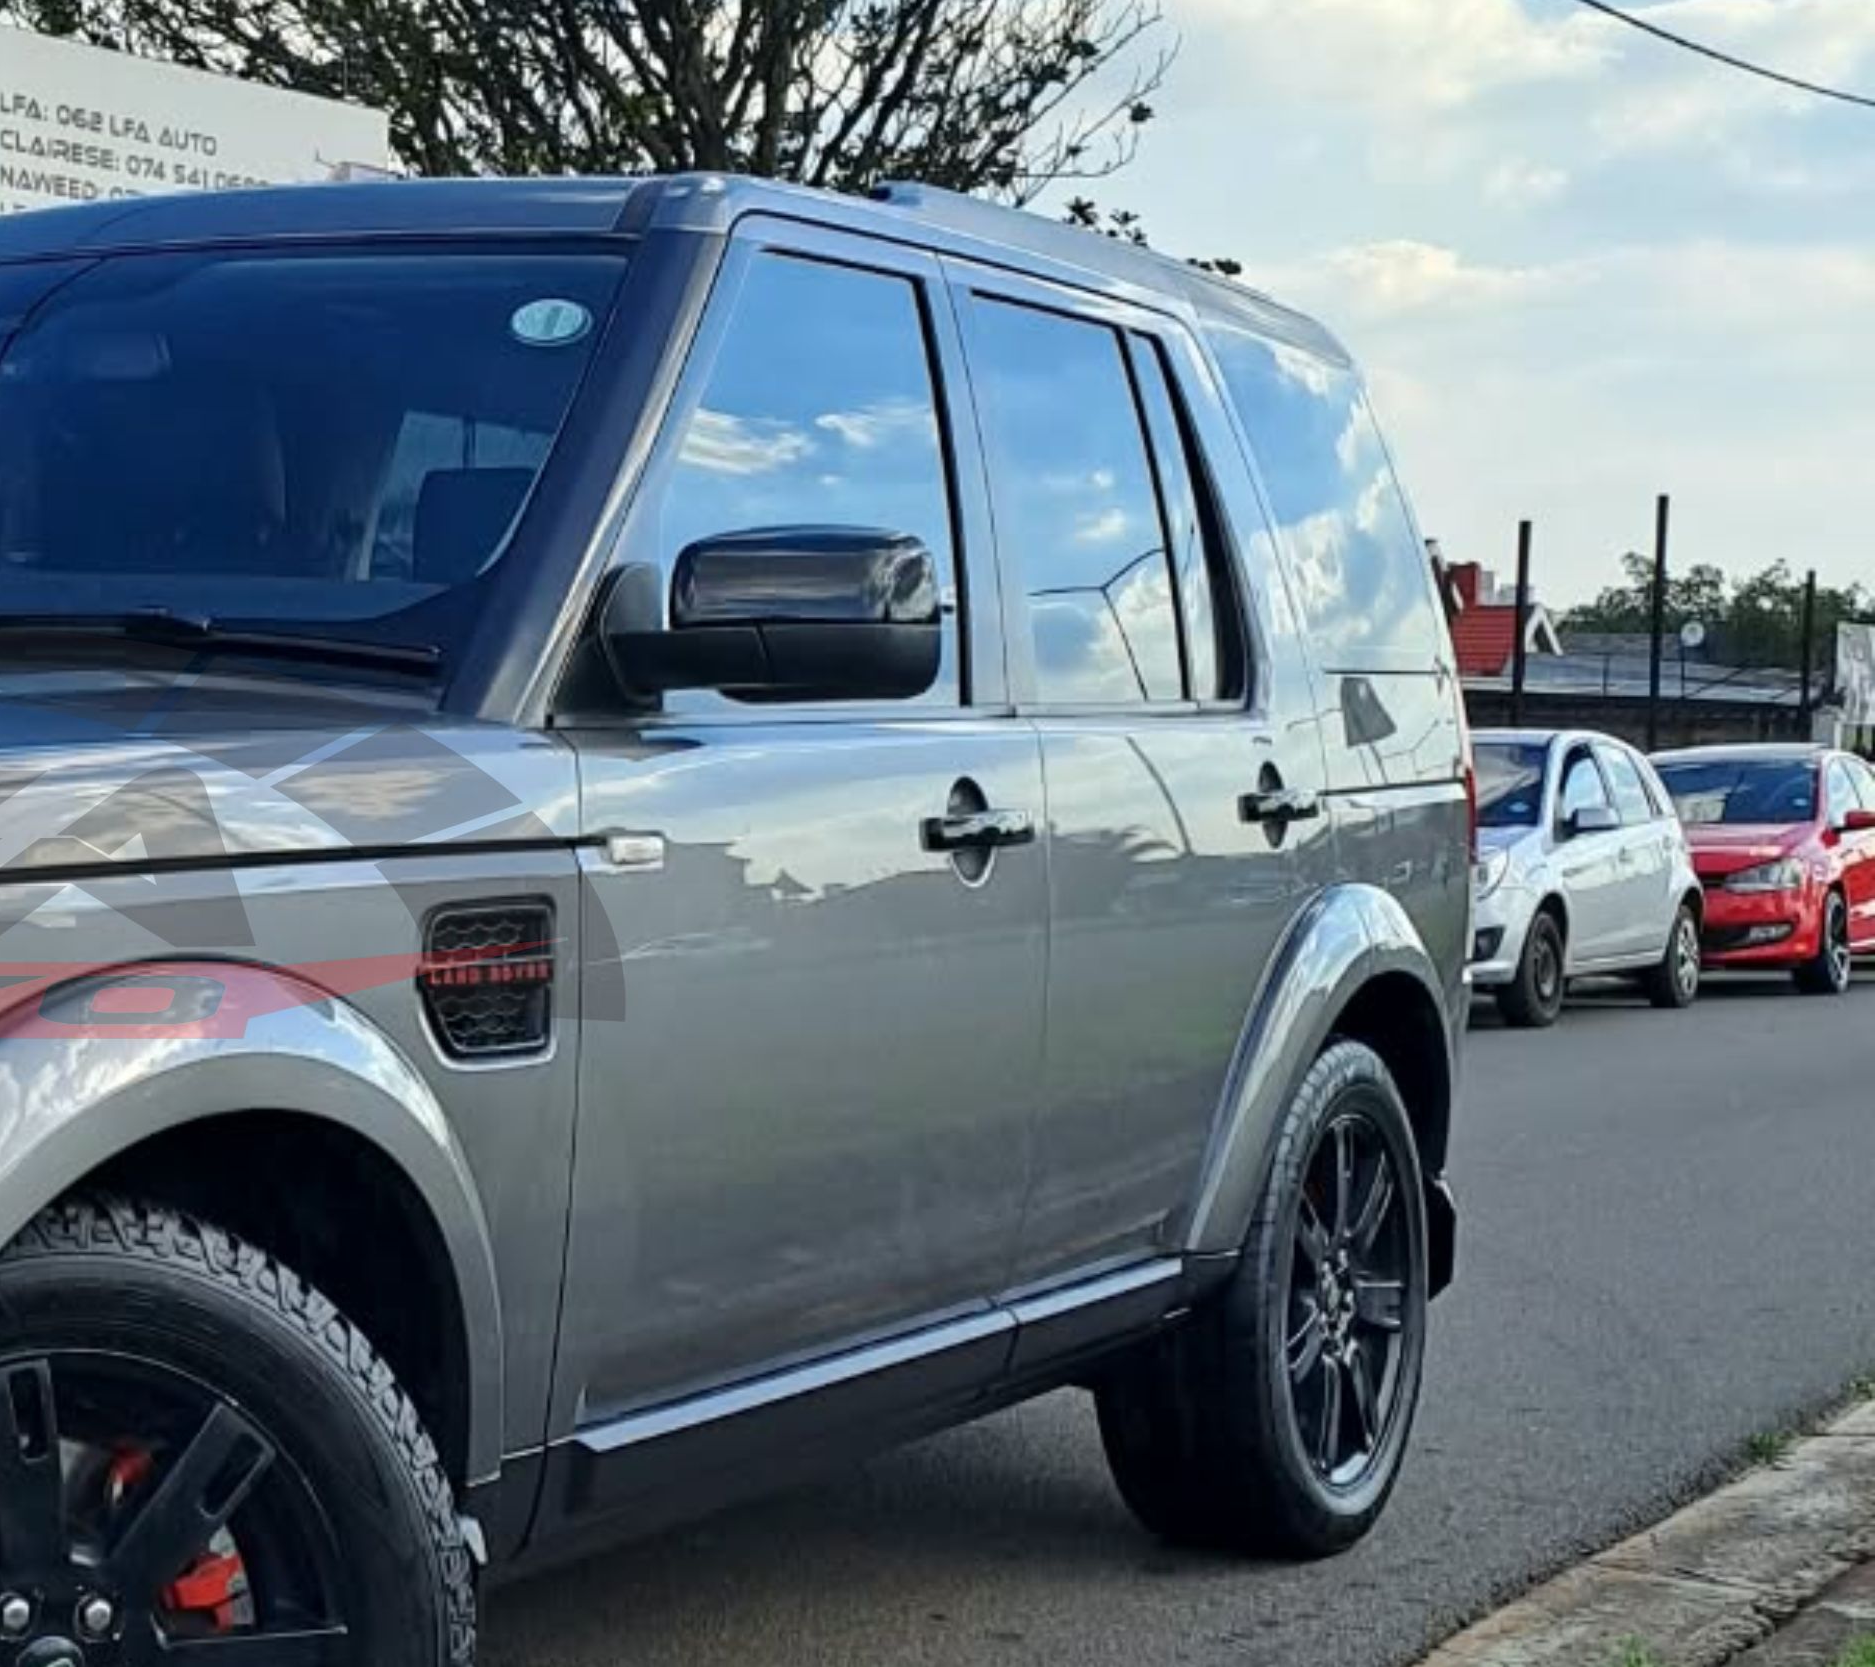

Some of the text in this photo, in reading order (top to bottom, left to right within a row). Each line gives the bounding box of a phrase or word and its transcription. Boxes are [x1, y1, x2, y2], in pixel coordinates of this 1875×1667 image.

[0, 92, 218, 157] LFA: 062 LFA AUTO
[0, 129, 121, 172] CLAIRESE:
[126, 154, 166, 181] 074
